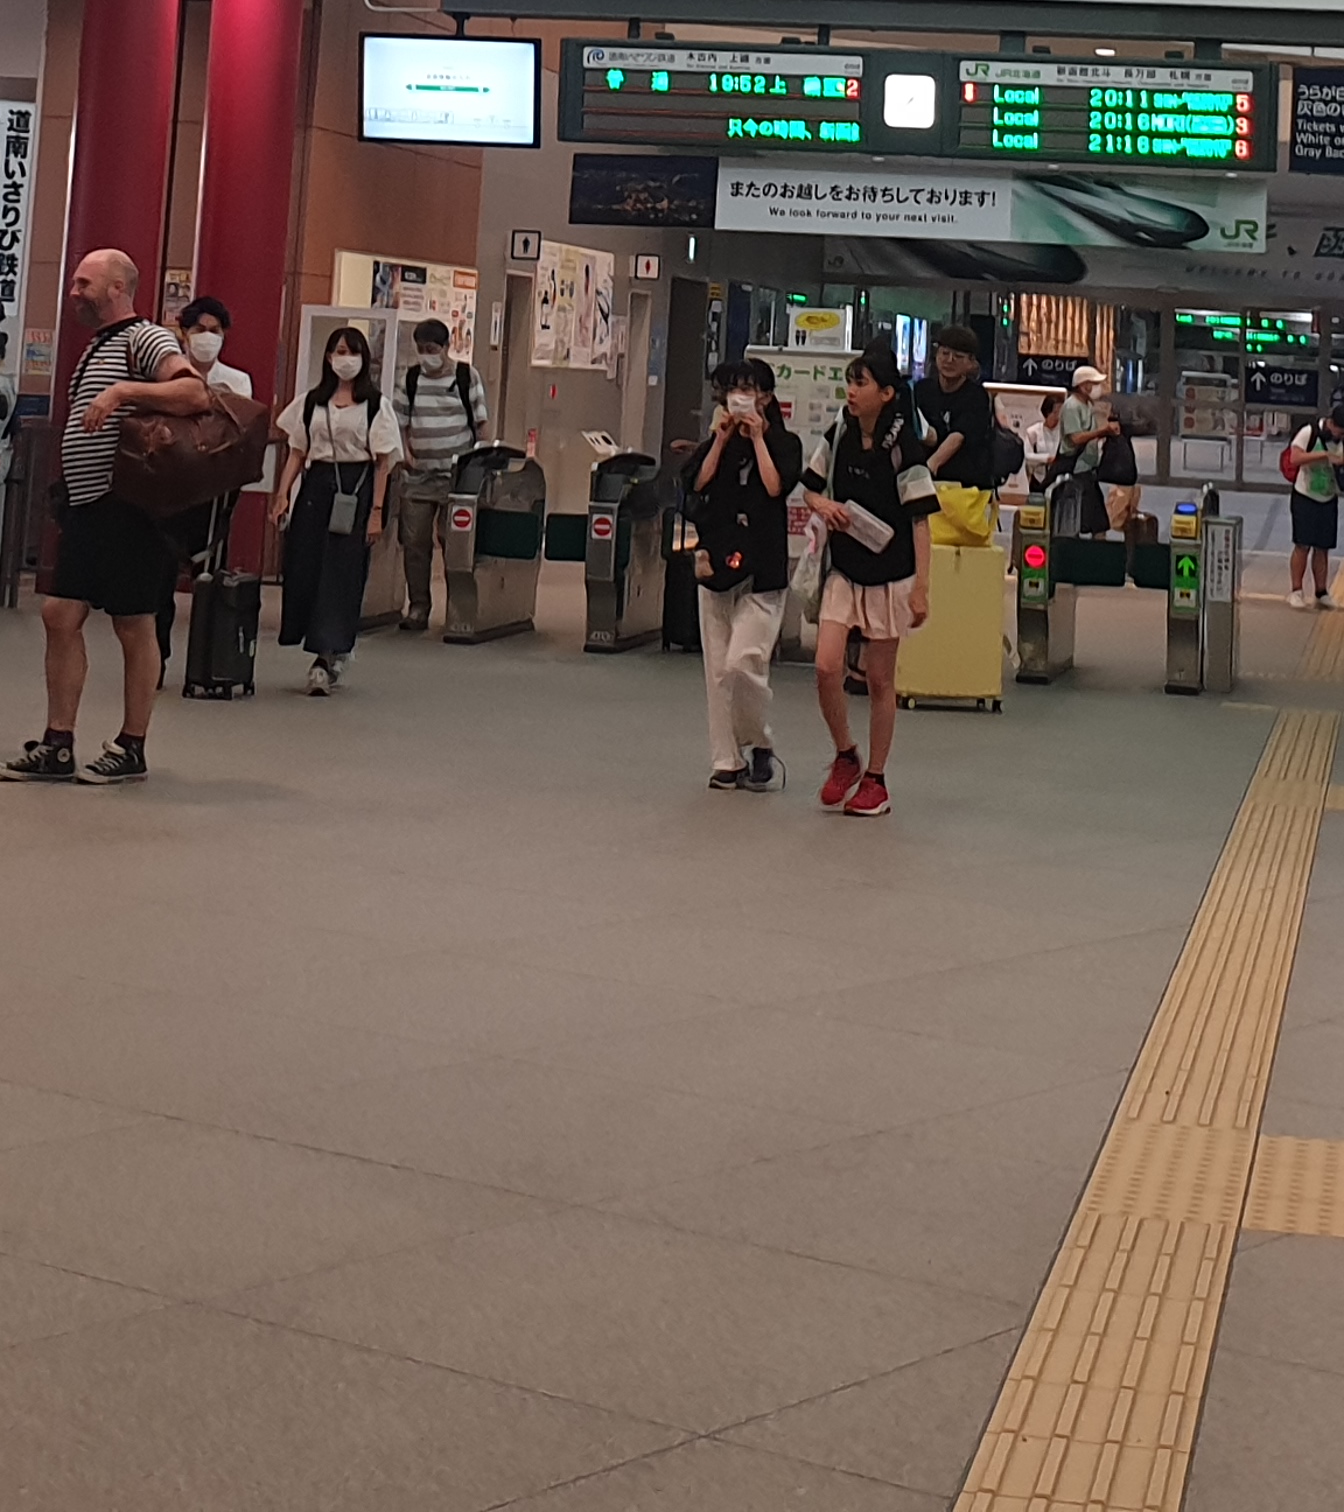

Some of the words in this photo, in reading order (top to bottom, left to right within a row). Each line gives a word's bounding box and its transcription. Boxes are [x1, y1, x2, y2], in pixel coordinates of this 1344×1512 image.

[966, 62, 990, 78] JR
[993, 83, 1040, 104] Local
[1090, 88, 1147, 109] 20:11
[993, 106, 1039, 127] Local
[1296, 119, 1336, 133] Tickets
[992, 128, 1039, 149] Local
[1296, 132, 1330, 146] White
[1295, 145, 1322, 160] Gray
[729, 180, 997, 208] またのお越しをお待ちしております!
[769, 205, 786, 217] We
[789, 207, 812, 218] look
[816, 208, 858, 220] forward
[861, 210, 872, 220] to
[875, 212, 900, 223] your
[904, 213, 928, 223] next
[1220, 219, 1260, 241] JR
[1269, 371, 1309, 384] のりば
